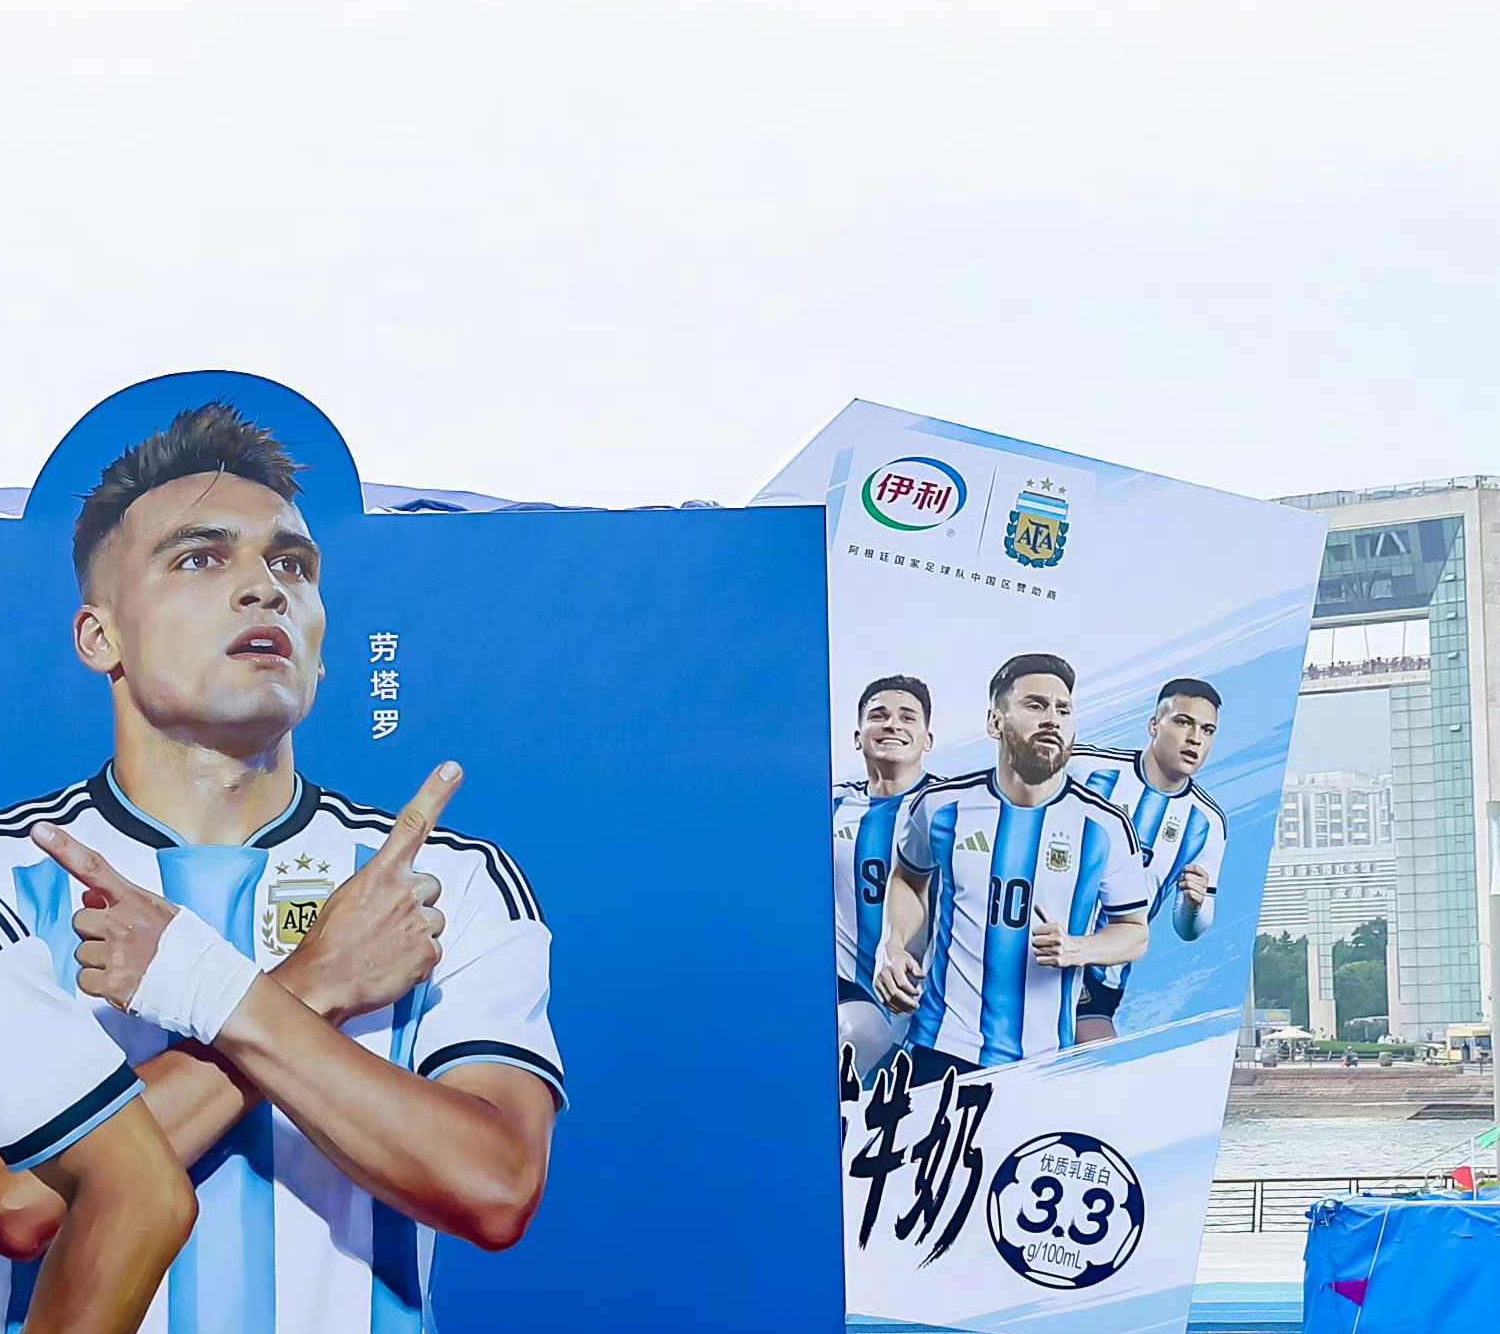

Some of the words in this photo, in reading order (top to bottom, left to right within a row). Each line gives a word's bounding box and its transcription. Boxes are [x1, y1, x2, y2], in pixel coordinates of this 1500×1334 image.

[875, 473, 953, 515] 伊利
[1015, 521, 1054, 553] AFA
[848, 544, 1057, 600] 阿根廷国家足球队中国区赞助商
[368, 632, 400, 742] 劳塔罗
[841, 1044, 994, 1271] 牛奶
[1040, 1153, 1111, 1185] 优质乳蛋白
[1016, 1176, 1115, 1246] 3.3
[1027, 1241, 1082, 1270] g/100mL
